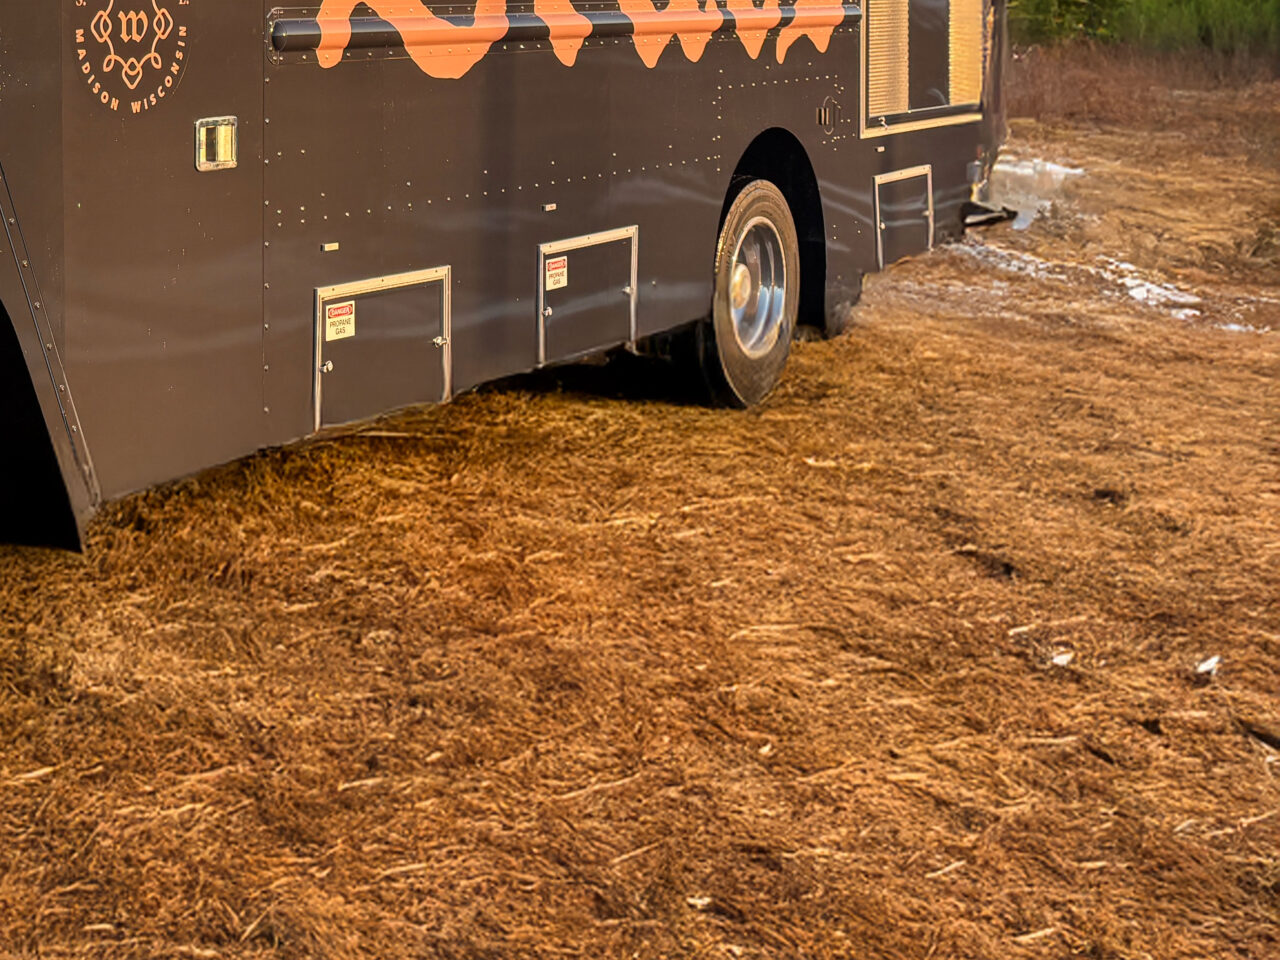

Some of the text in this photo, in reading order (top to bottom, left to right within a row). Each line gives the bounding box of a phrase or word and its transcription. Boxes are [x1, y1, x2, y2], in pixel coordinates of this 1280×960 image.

[75, 26, 188, 114] MADISON WISCONSIN
[330, 318, 351, 328] PROPANE
[335, 327, 346, 335] GAS
